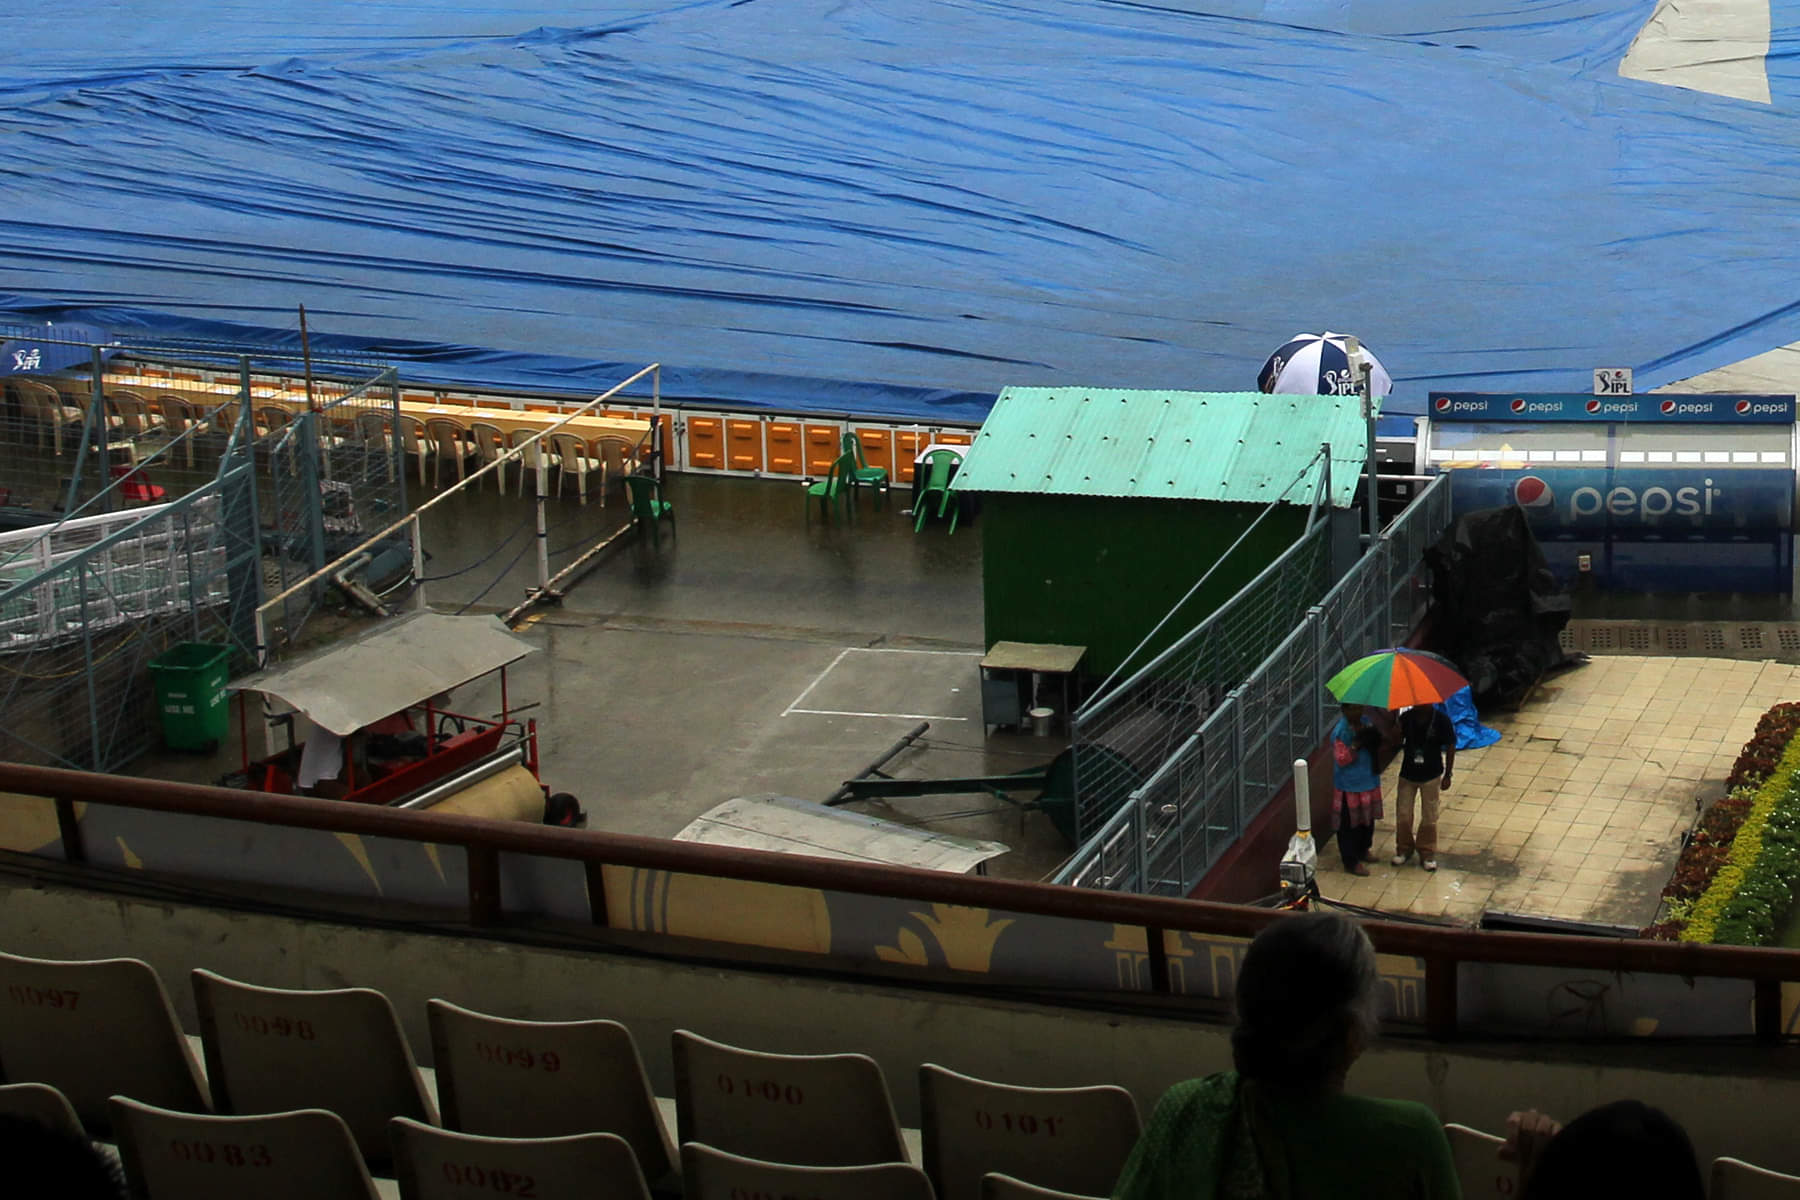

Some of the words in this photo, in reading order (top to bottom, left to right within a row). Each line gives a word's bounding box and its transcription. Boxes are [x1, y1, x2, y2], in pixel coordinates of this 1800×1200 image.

[1611, 382, 1630, 393] IPL
[1453, 400, 1488, 412] pepsi
[1528, 401, 1563, 413] pepsi
[1604, 402, 1639, 414] pepsi
[1678, 402, 1713, 414] pepsi
[1753, 402, 1788, 414] pepsi
[1569, 478, 1713, 522] pepsi
